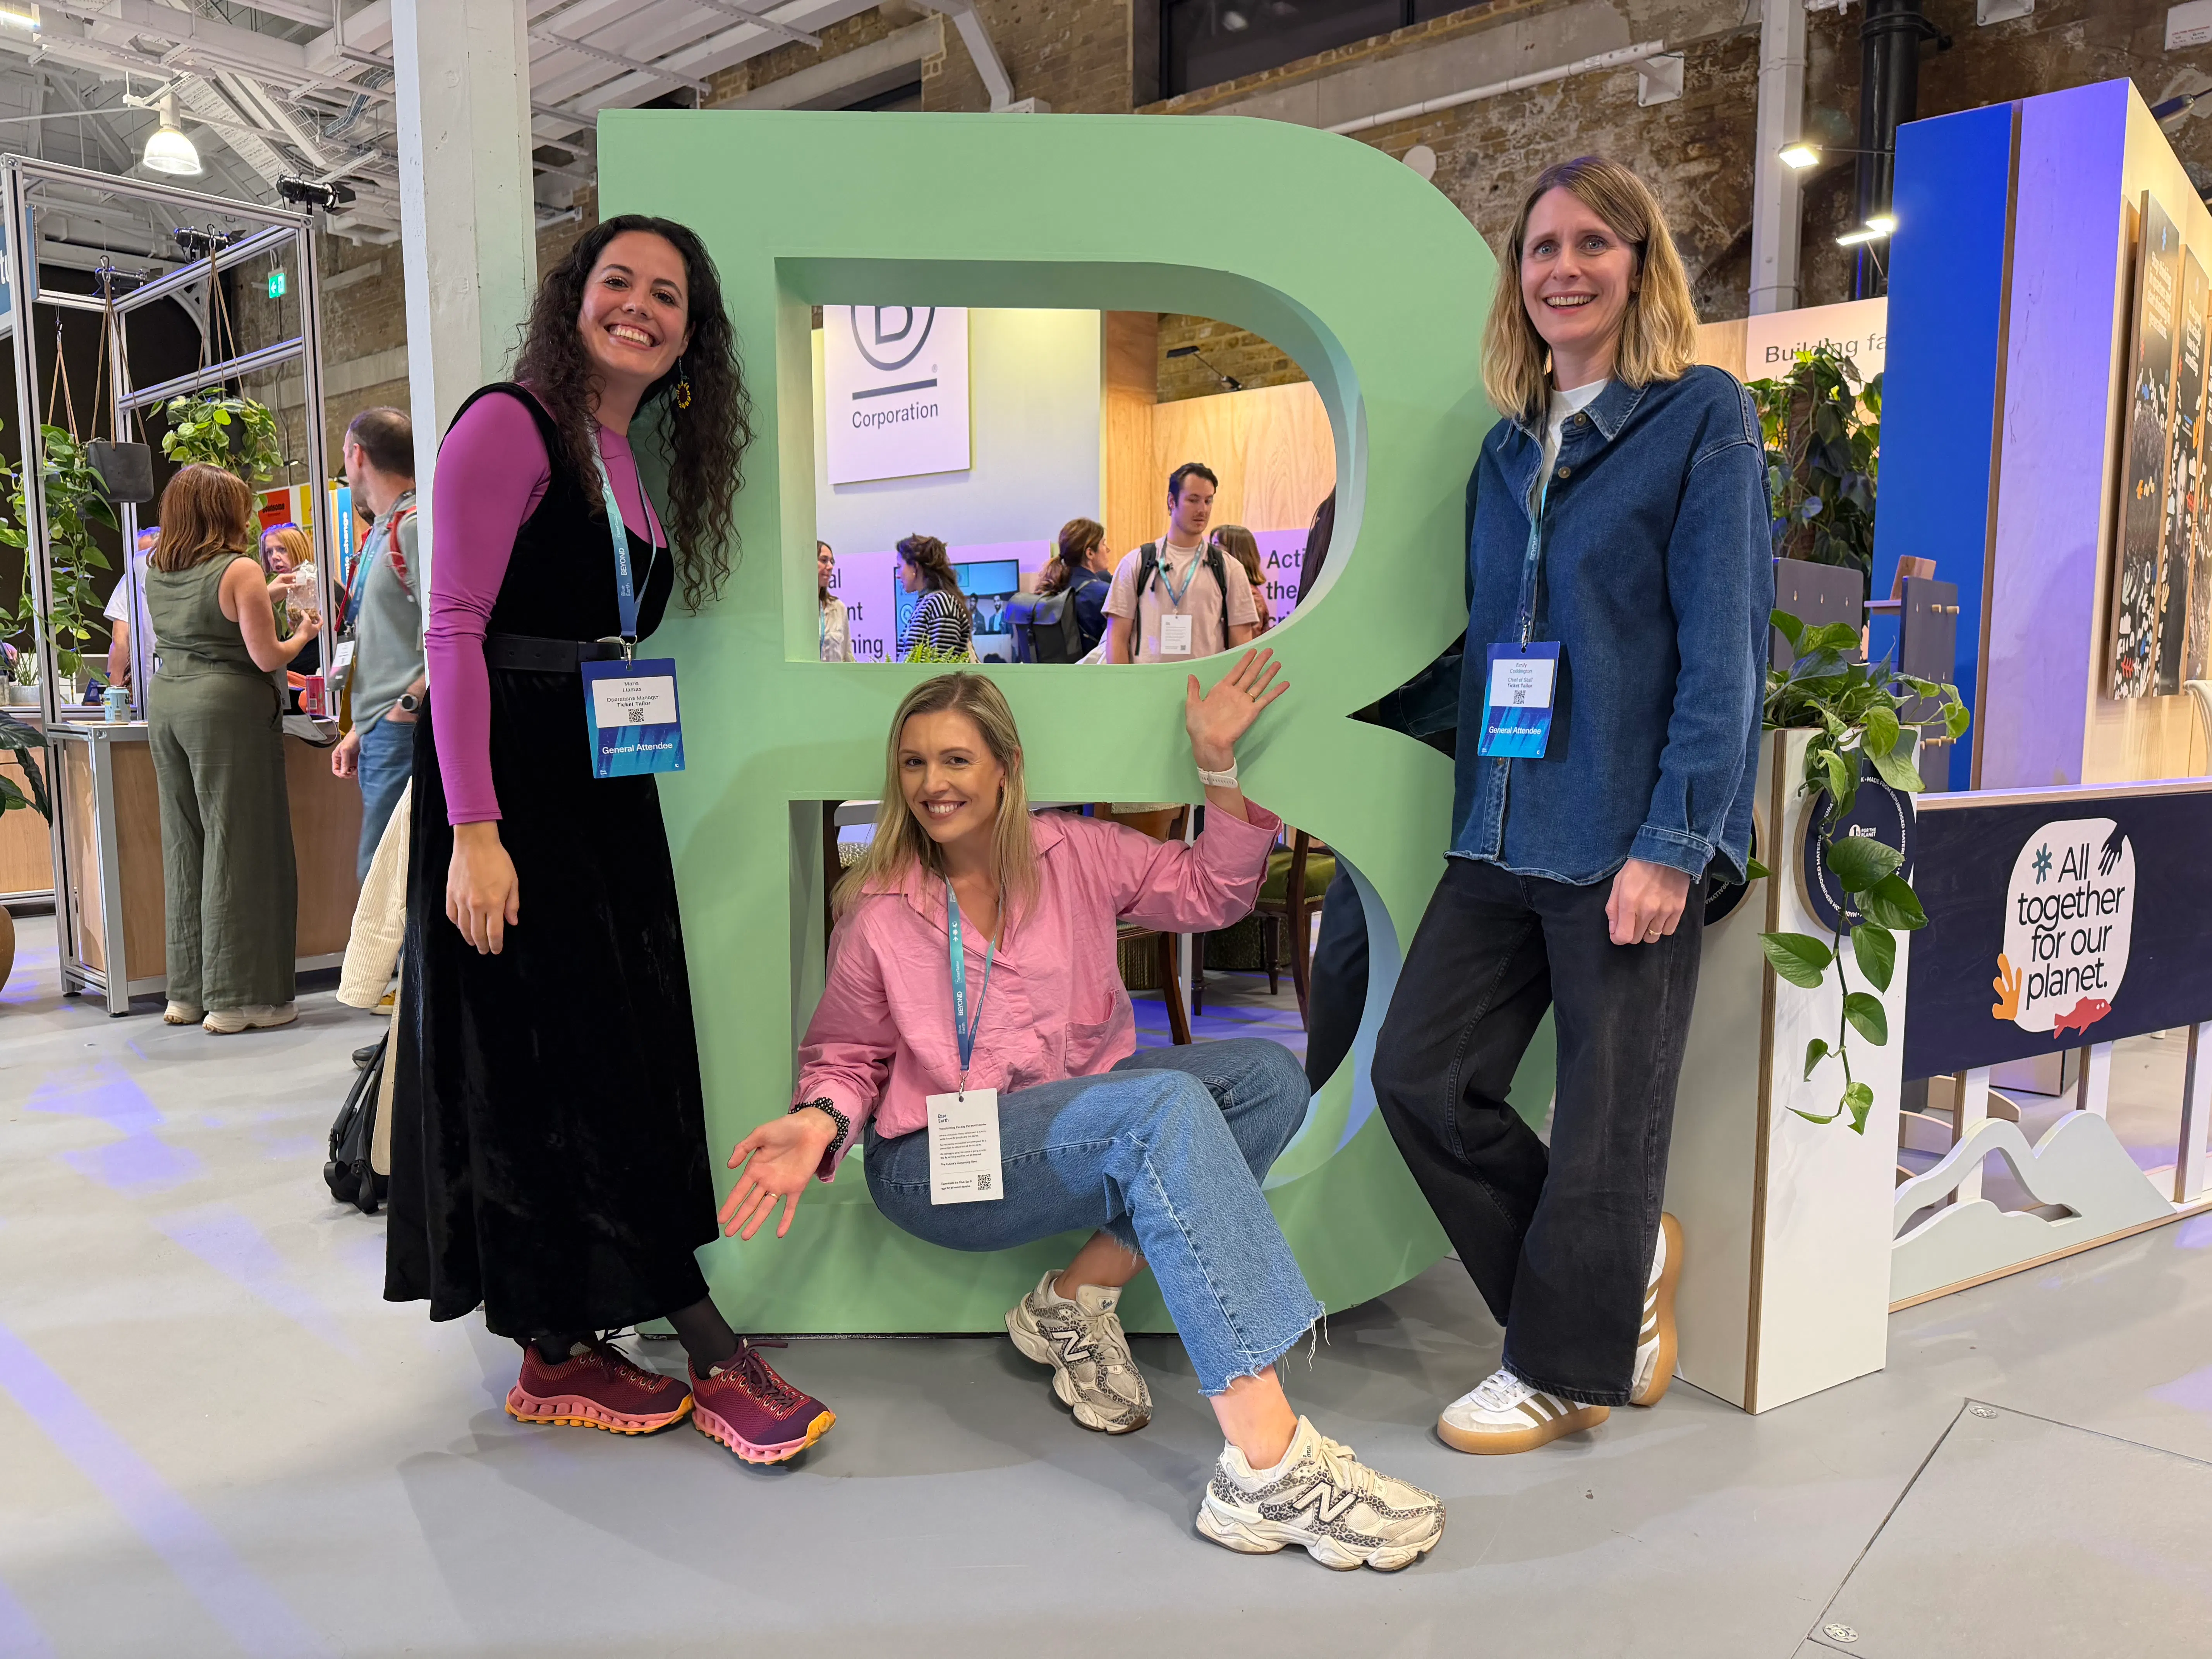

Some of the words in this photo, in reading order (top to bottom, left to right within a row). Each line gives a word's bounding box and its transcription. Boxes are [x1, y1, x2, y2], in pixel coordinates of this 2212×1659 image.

[852, 402, 938, 429] Corporation
[619, 548, 627, 575] BEYOND
[1529, 534, 1538, 560] BEYOND
[1266, 581, 1297, 599] the
[1513, 726, 1541, 735] Attendee
[602, 745, 634, 754] General
[636, 742, 673, 751] Attendee
[1867, 776, 1879, 785] MADE
[1880, 781, 1891, 793] FROM
[1890, 791, 1905, 829] REPURPOSED
[2058, 843, 2090, 883] All
[2018, 881, 2125, 930] together
[2031, 924, 2066, 962] for
[2071, 924, 2112, 956] our
[2026, 957, 2108, 1010] planet.
[1292, 1480, 1359, 1524] N
